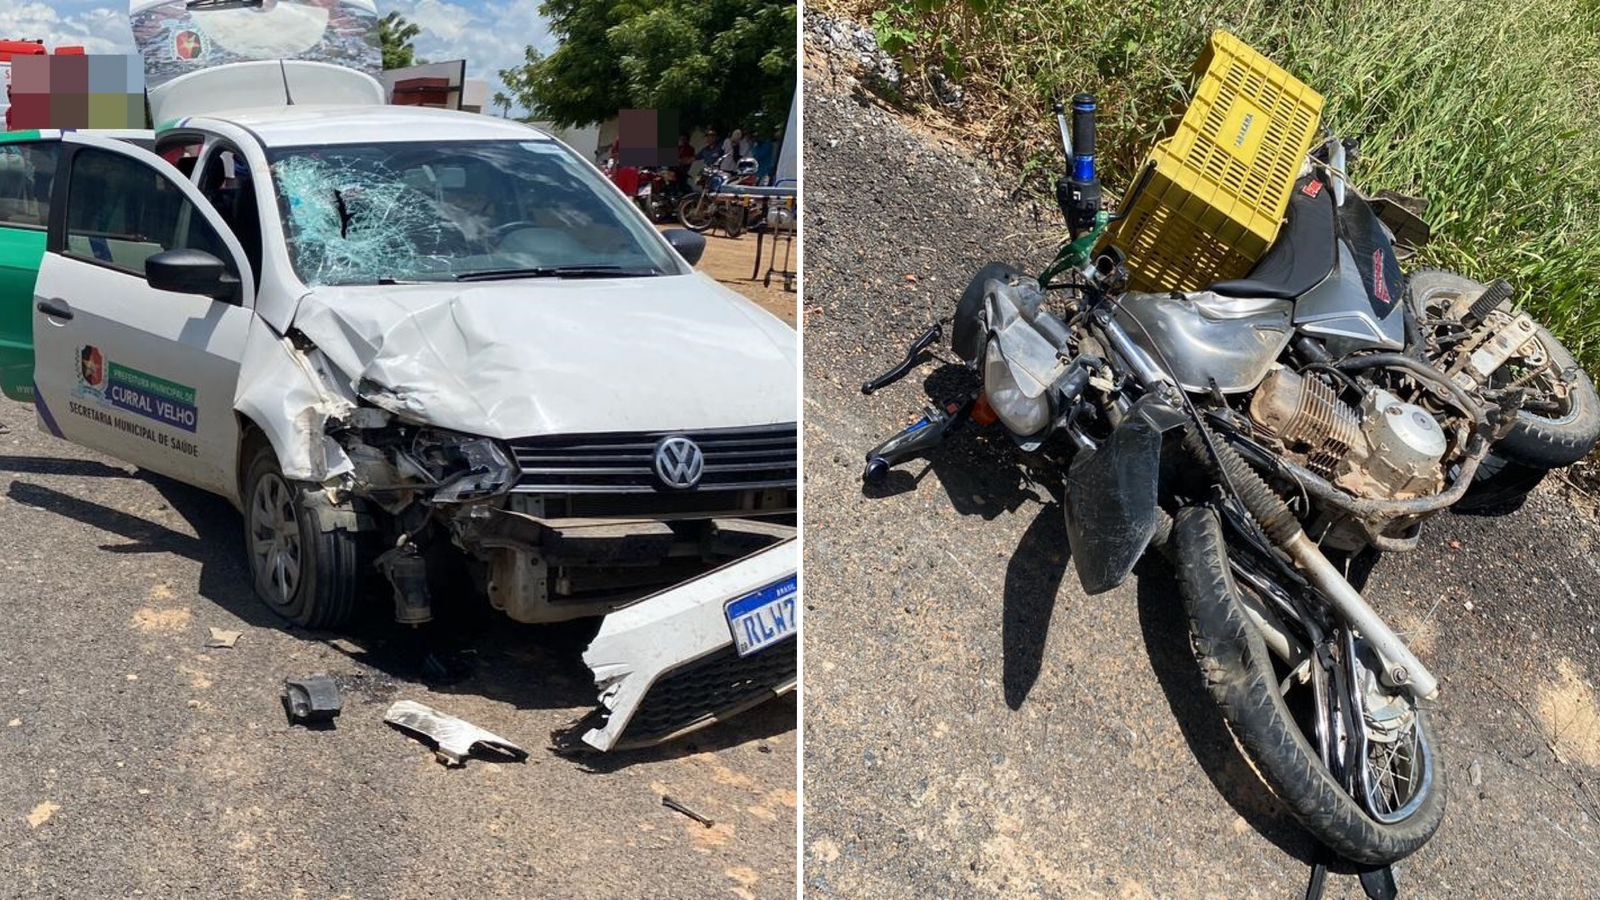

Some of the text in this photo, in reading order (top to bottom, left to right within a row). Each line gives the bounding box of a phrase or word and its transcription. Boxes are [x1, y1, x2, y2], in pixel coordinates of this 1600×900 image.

[69, 401, 113, 427] SECRETARIA
[114, 417, 156, 442] MUNICIPAL
[158, 433, 168, 446] DE
[111, 386, 152, 413] CURRAL
[155, 401, 195, 426] VELHO
[742, 597, 795, 647] RLW7
